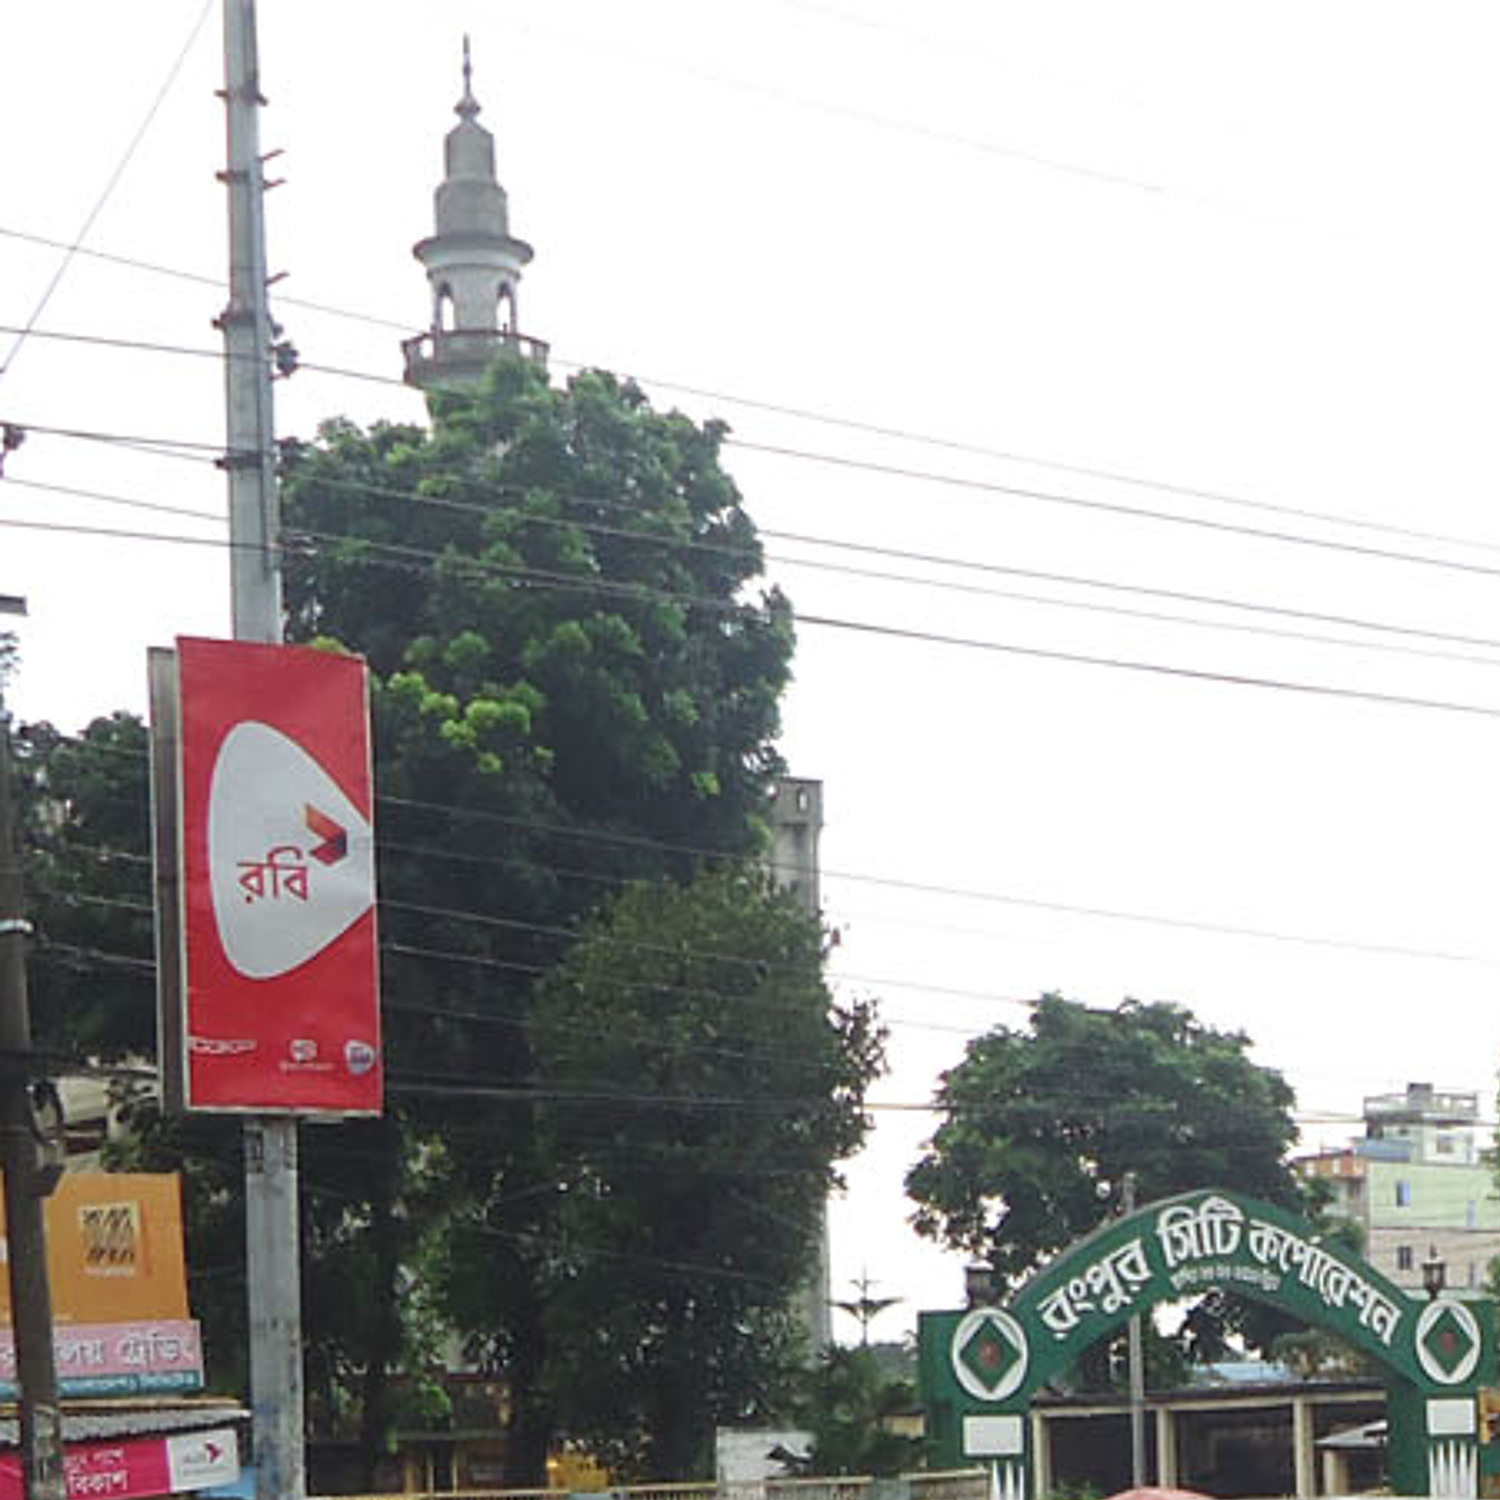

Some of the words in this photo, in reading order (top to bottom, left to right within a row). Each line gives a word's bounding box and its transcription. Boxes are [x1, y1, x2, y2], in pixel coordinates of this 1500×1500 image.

[236, 846, 308, 904] রবি
[1036, 1238, 1152, 1341] রংপুর
[1156, 1196, 1244, 1268] সিটি
[1249, 1218, 1402, 1347] কর্পোরেশন
